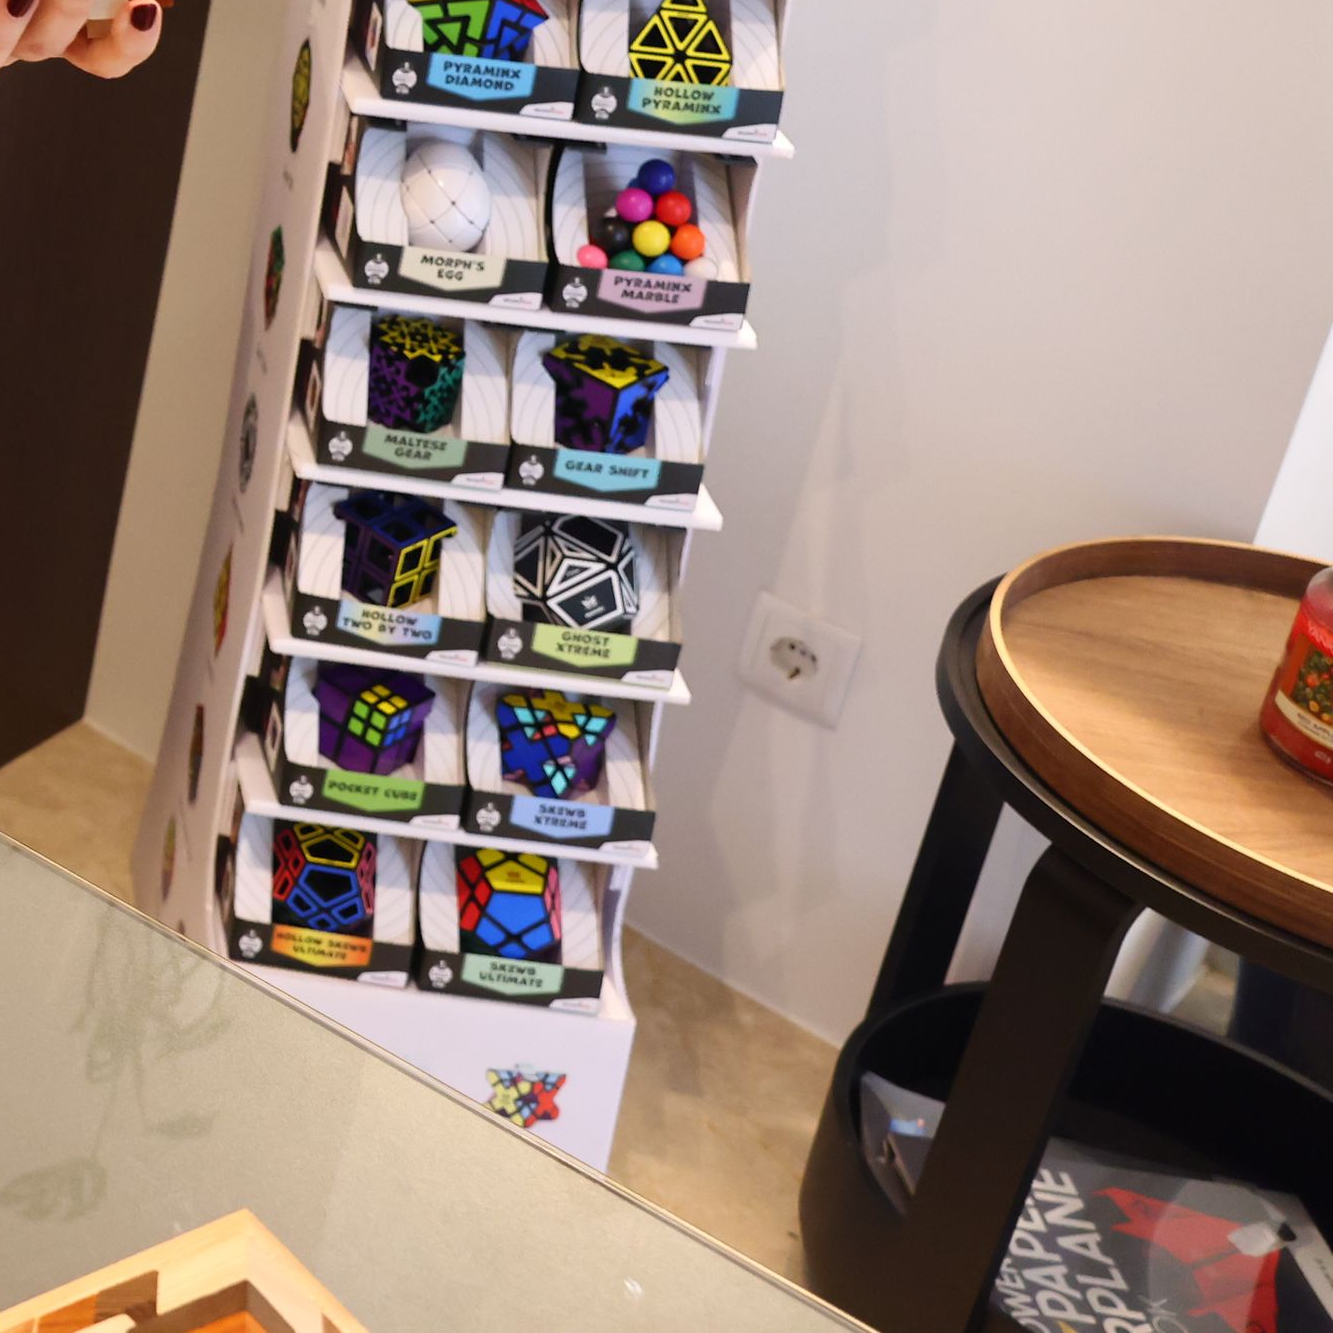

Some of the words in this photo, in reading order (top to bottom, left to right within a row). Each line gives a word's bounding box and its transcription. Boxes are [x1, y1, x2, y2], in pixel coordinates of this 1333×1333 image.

[443, 60, 522, 80] PYRAMINX
[445, 74, 515, 92] DIAMOND
[653, 85, 716, 102] HOLLOW
[641, 97, 723, 115] PYRAMINX
[420, 254, 485, 272] MORPH'S
[437, 269, 464, 281] EGG
[614, 275, 693, 293] PYRAMINX
[621, 289, 680, 304] MARBLE
[384, 434, 448, 451] MALTESE
[394, 448, 433, 462] GEAR
[565, 459, 604, 475] GEAR
[609, 463, 650, 480] SHIFT
[361, 609, 418, 626] HOLLOW
[342, 617, 371, 631] TWO
[377, 622, 397, 634] BY
[400, 627, 434, 640] TWO
[561, 630, 610, 645] GHOST
[555, 643, 611, 659] XTREME
[328, 780, 380, 797] POCKET
[384, 788, 418, 802] CUBE
[538, 803, 587, 818] SKEWB
[533, 816, 589, 830] XTREME
[291, 944, 347, 961] ULTIMATE
[489, 961, 538, 976] SKEWB
[478, 972, 544, 989] ULTIMATE
